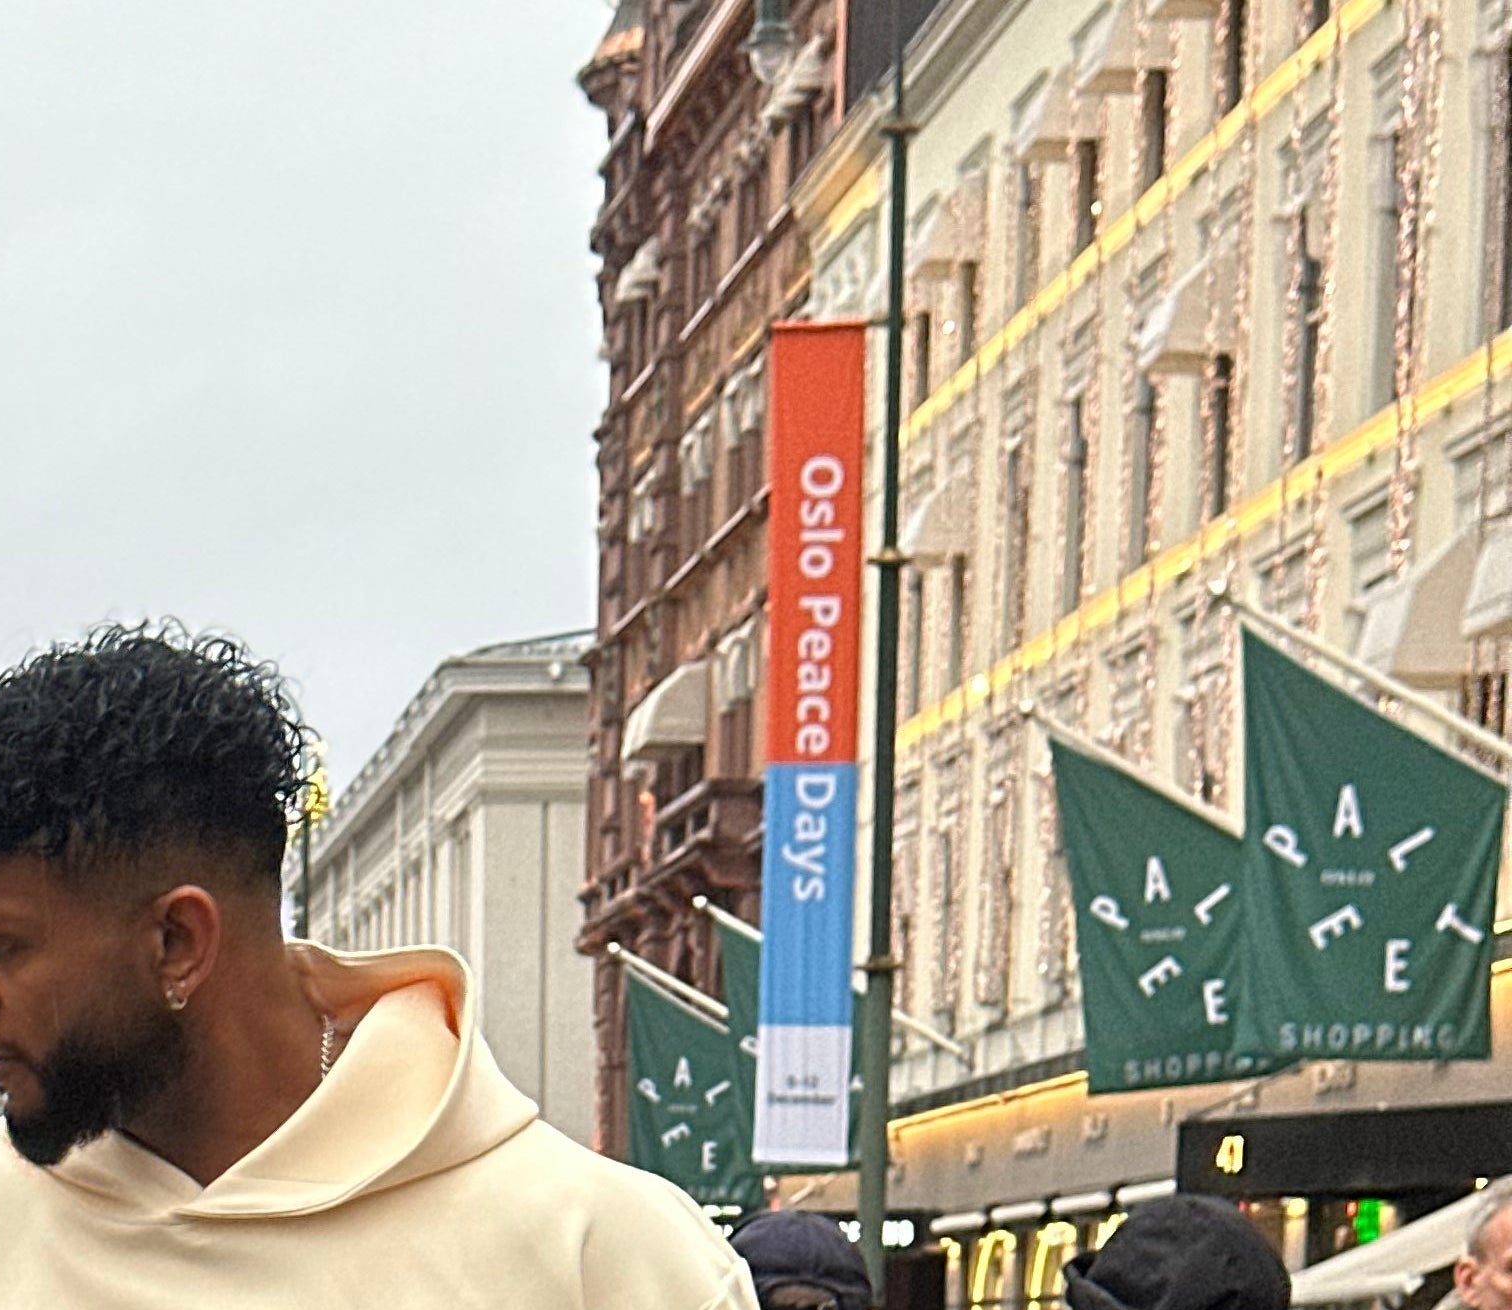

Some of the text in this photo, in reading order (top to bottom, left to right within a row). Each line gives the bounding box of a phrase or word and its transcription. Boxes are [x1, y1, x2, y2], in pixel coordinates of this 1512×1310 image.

[781, 455, 845, 903] Oslo Peace Days
[1277, 1021, 1459, 1052] SHOPPING
